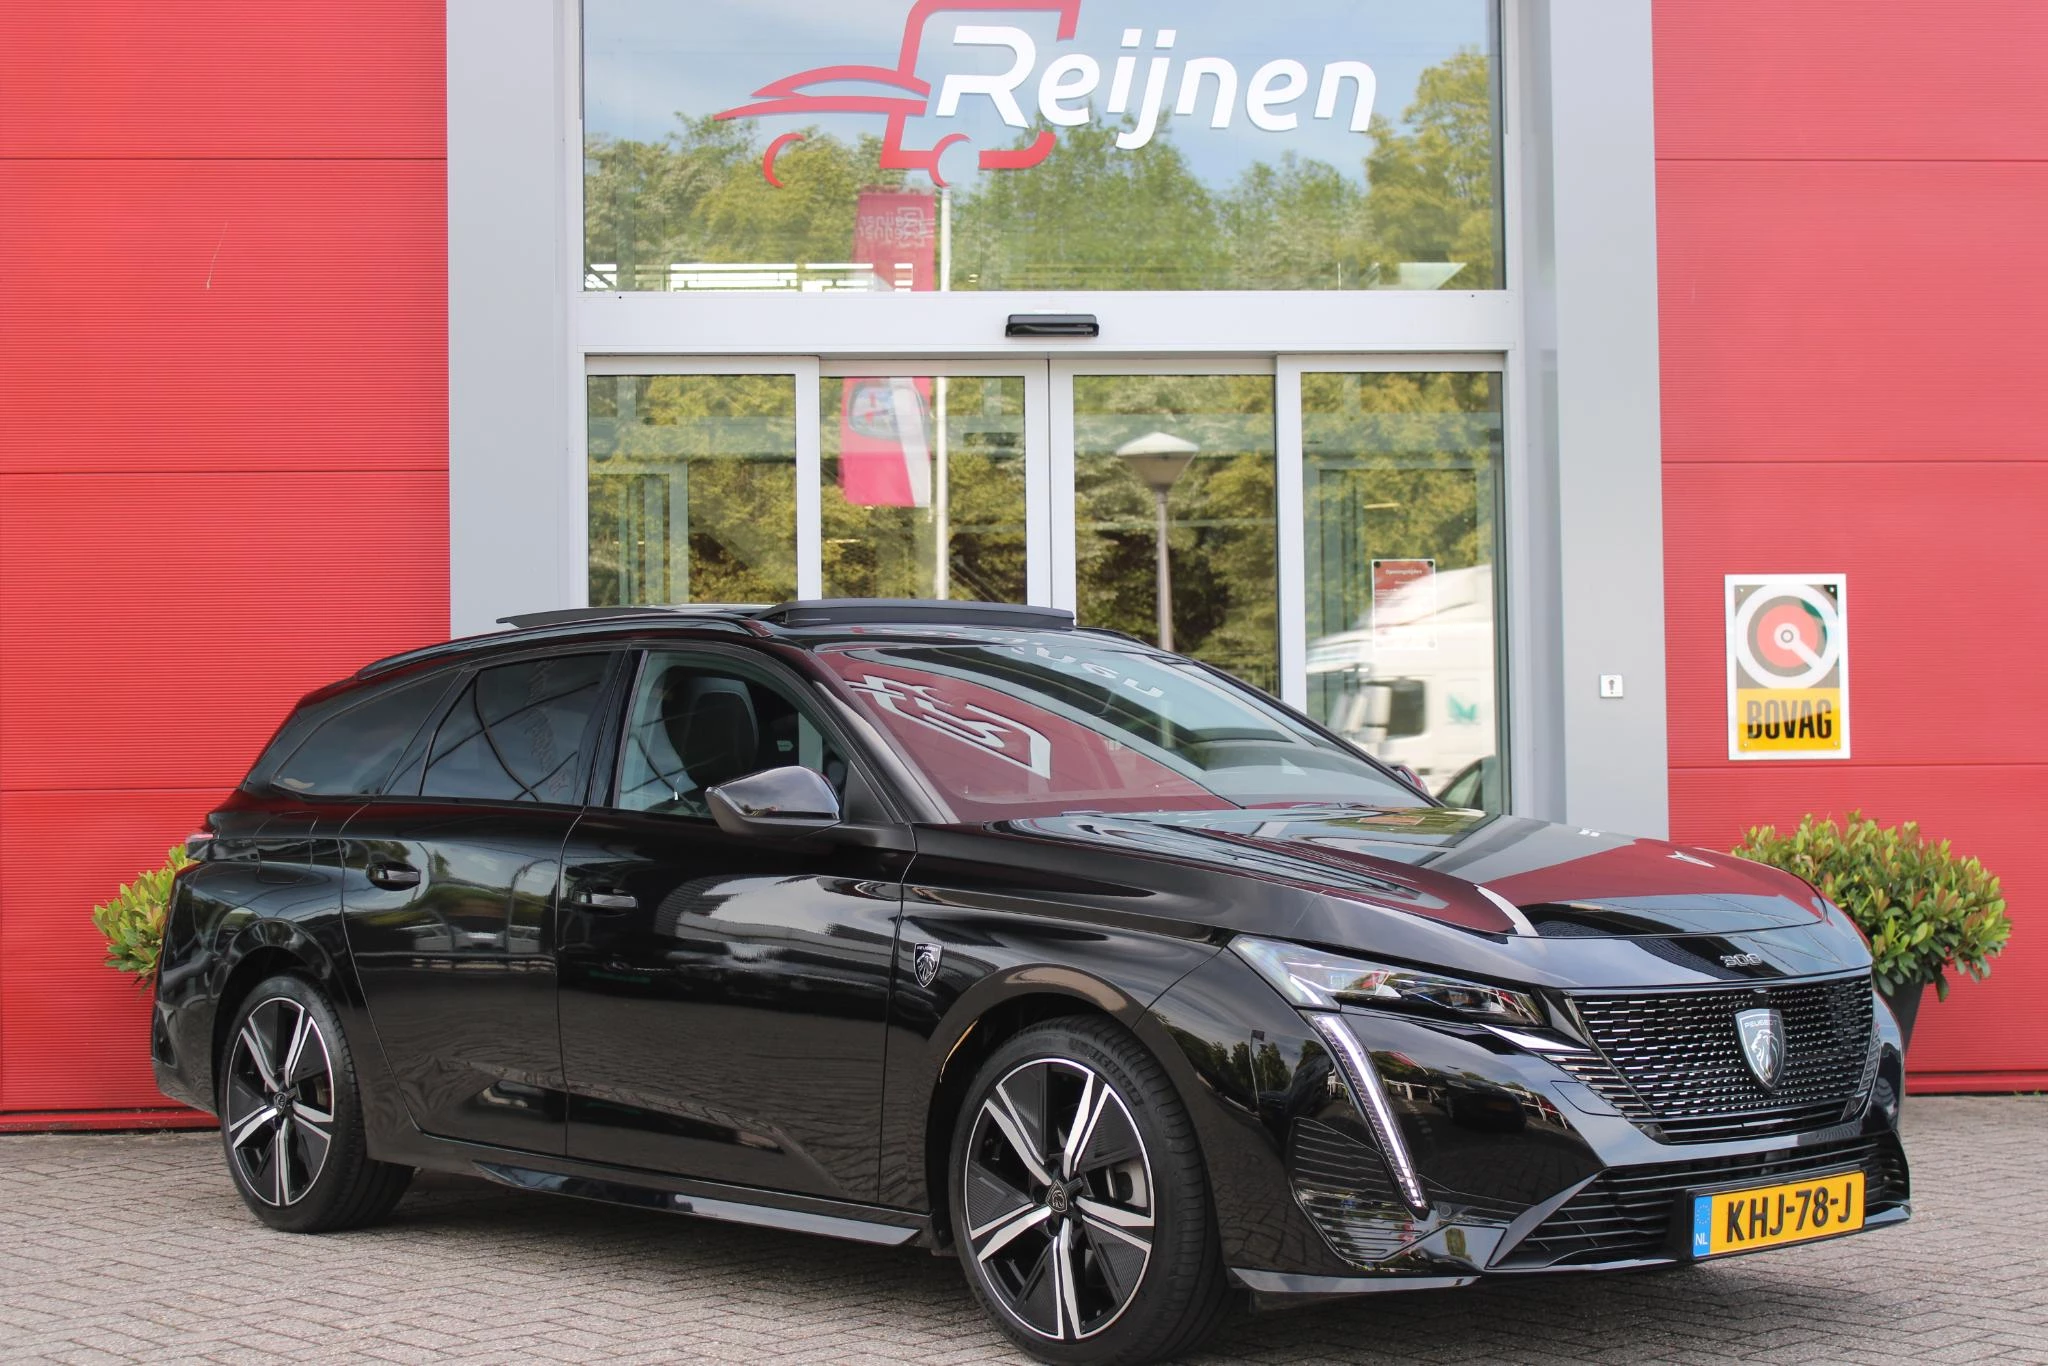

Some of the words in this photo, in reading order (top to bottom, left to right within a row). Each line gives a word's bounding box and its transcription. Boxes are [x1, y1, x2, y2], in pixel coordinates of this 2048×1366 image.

[935, 25, 1377, 150] Reijnen
[1747, 699, 1832, 739] BOVAG
[1720, 953, 1762, 968] 308
[1727, 1183, 1852, 1242] KHJ-78-J
[1695, 1232, 1708, 1246] NL
